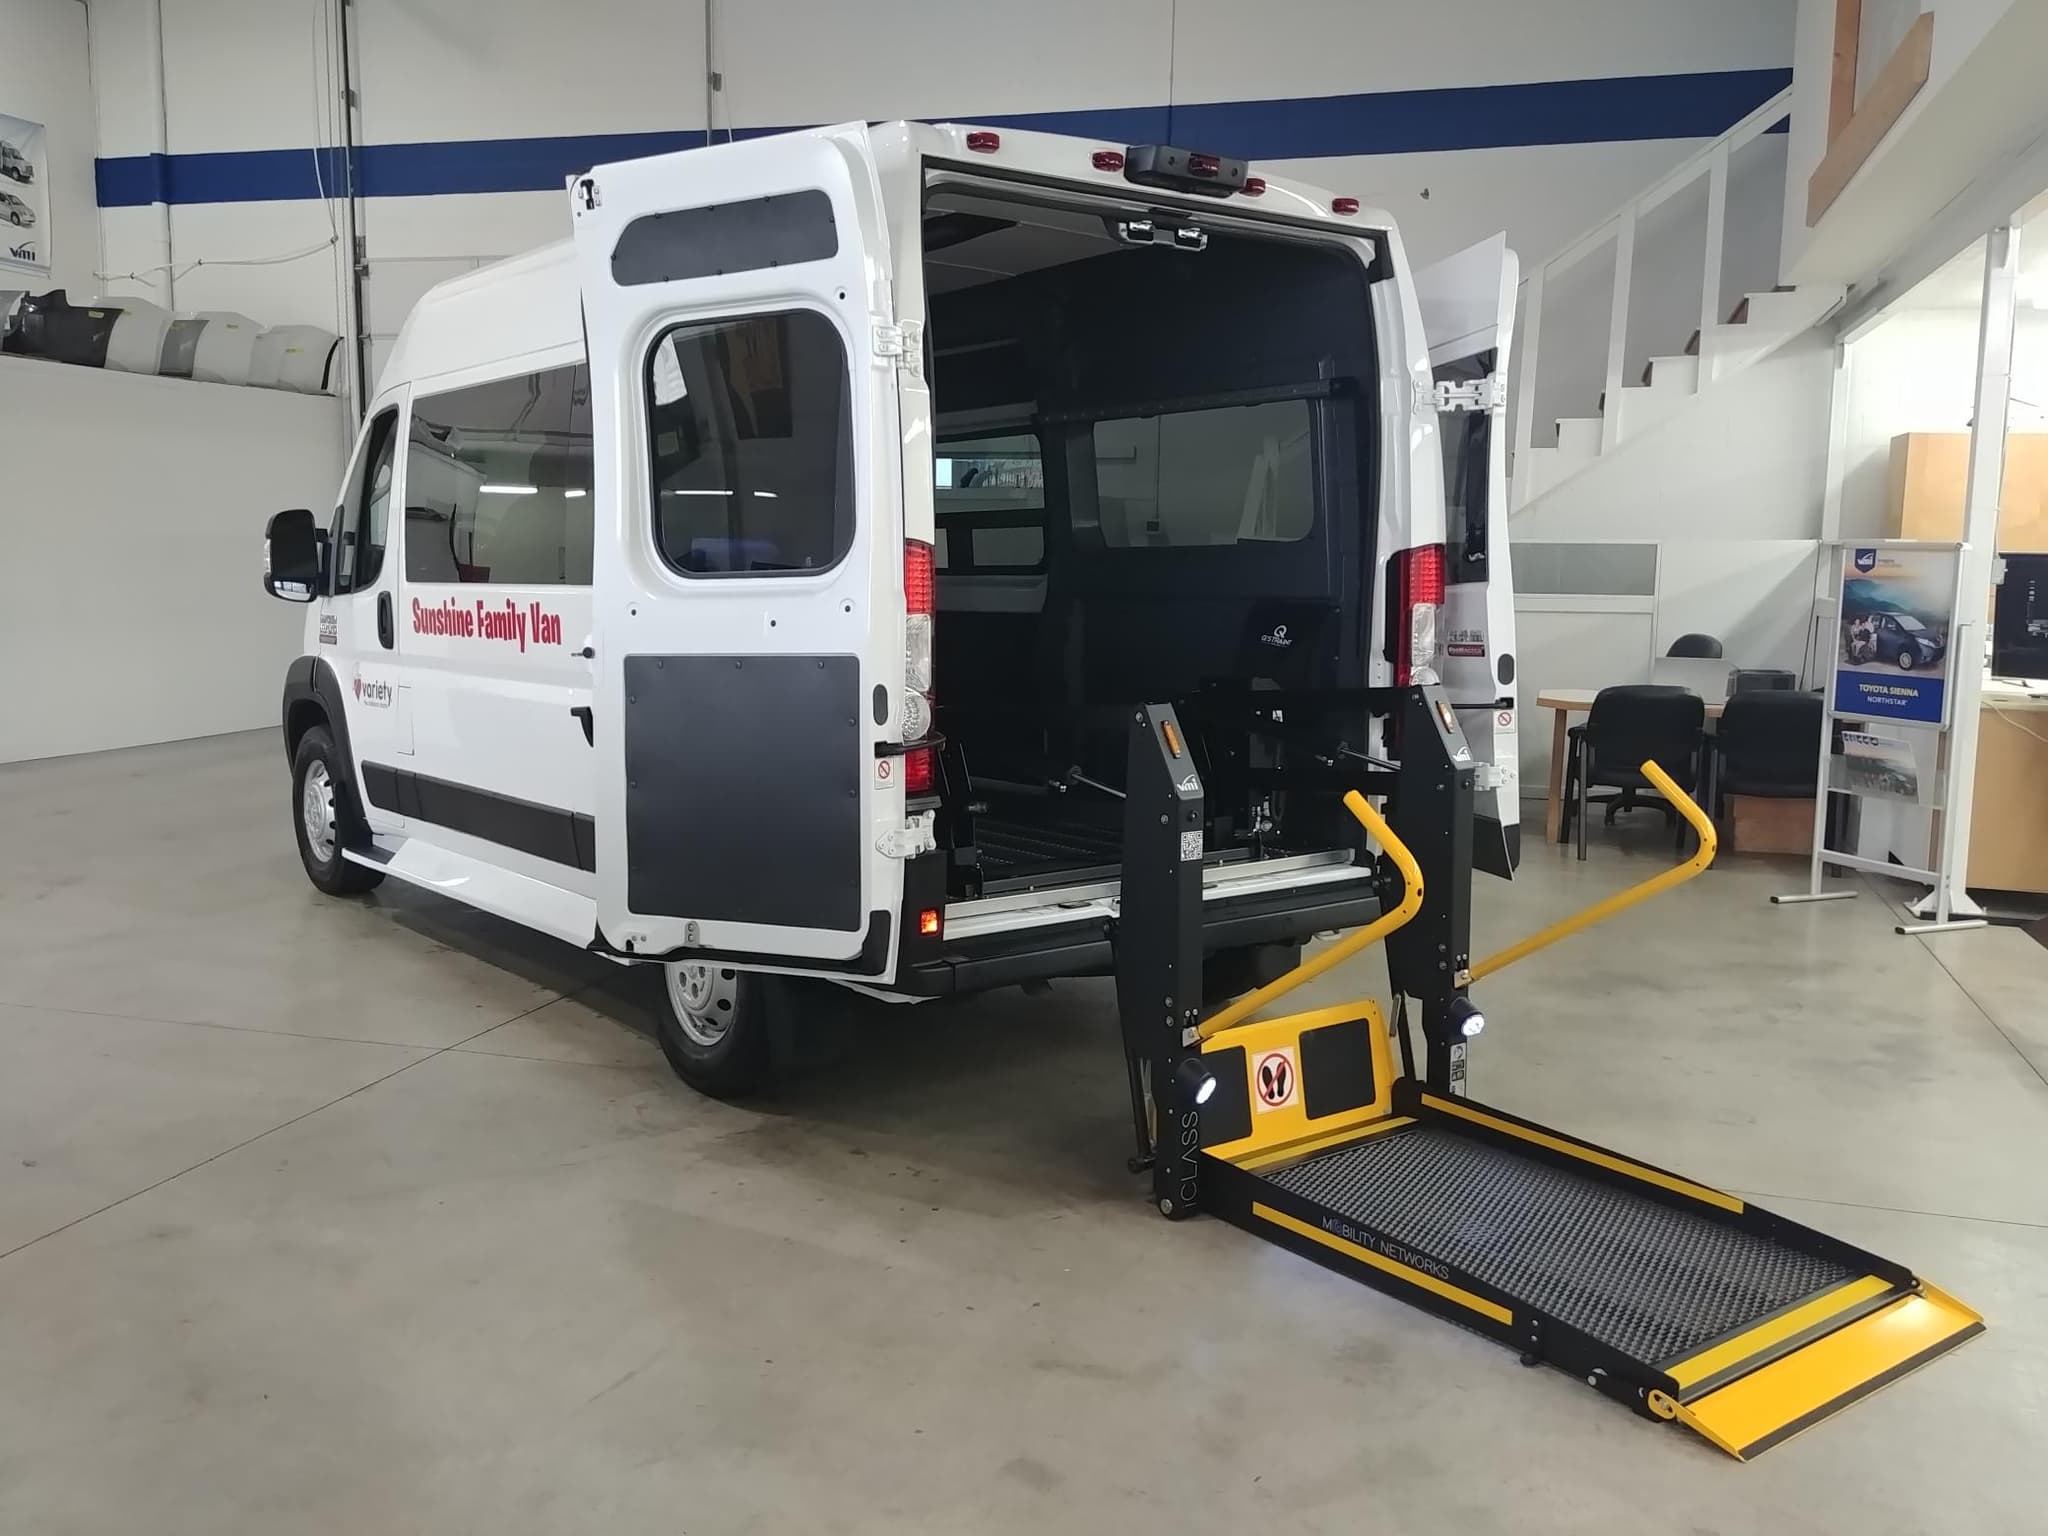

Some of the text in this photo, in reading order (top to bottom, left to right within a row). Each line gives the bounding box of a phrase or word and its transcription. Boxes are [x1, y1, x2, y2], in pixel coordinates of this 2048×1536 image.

[412, 596, 562, 653] Sunshine Family Van
[362, 680, 392, 707] variety
[1859, 684, 1919, 697] TOYOTA SIENNA
[1867, 696, 1908, 706] NORTHSTAR
[1177, 774, 1199, 792] vmi
[1380, 1239, 1450, 1280] NETWORKS
